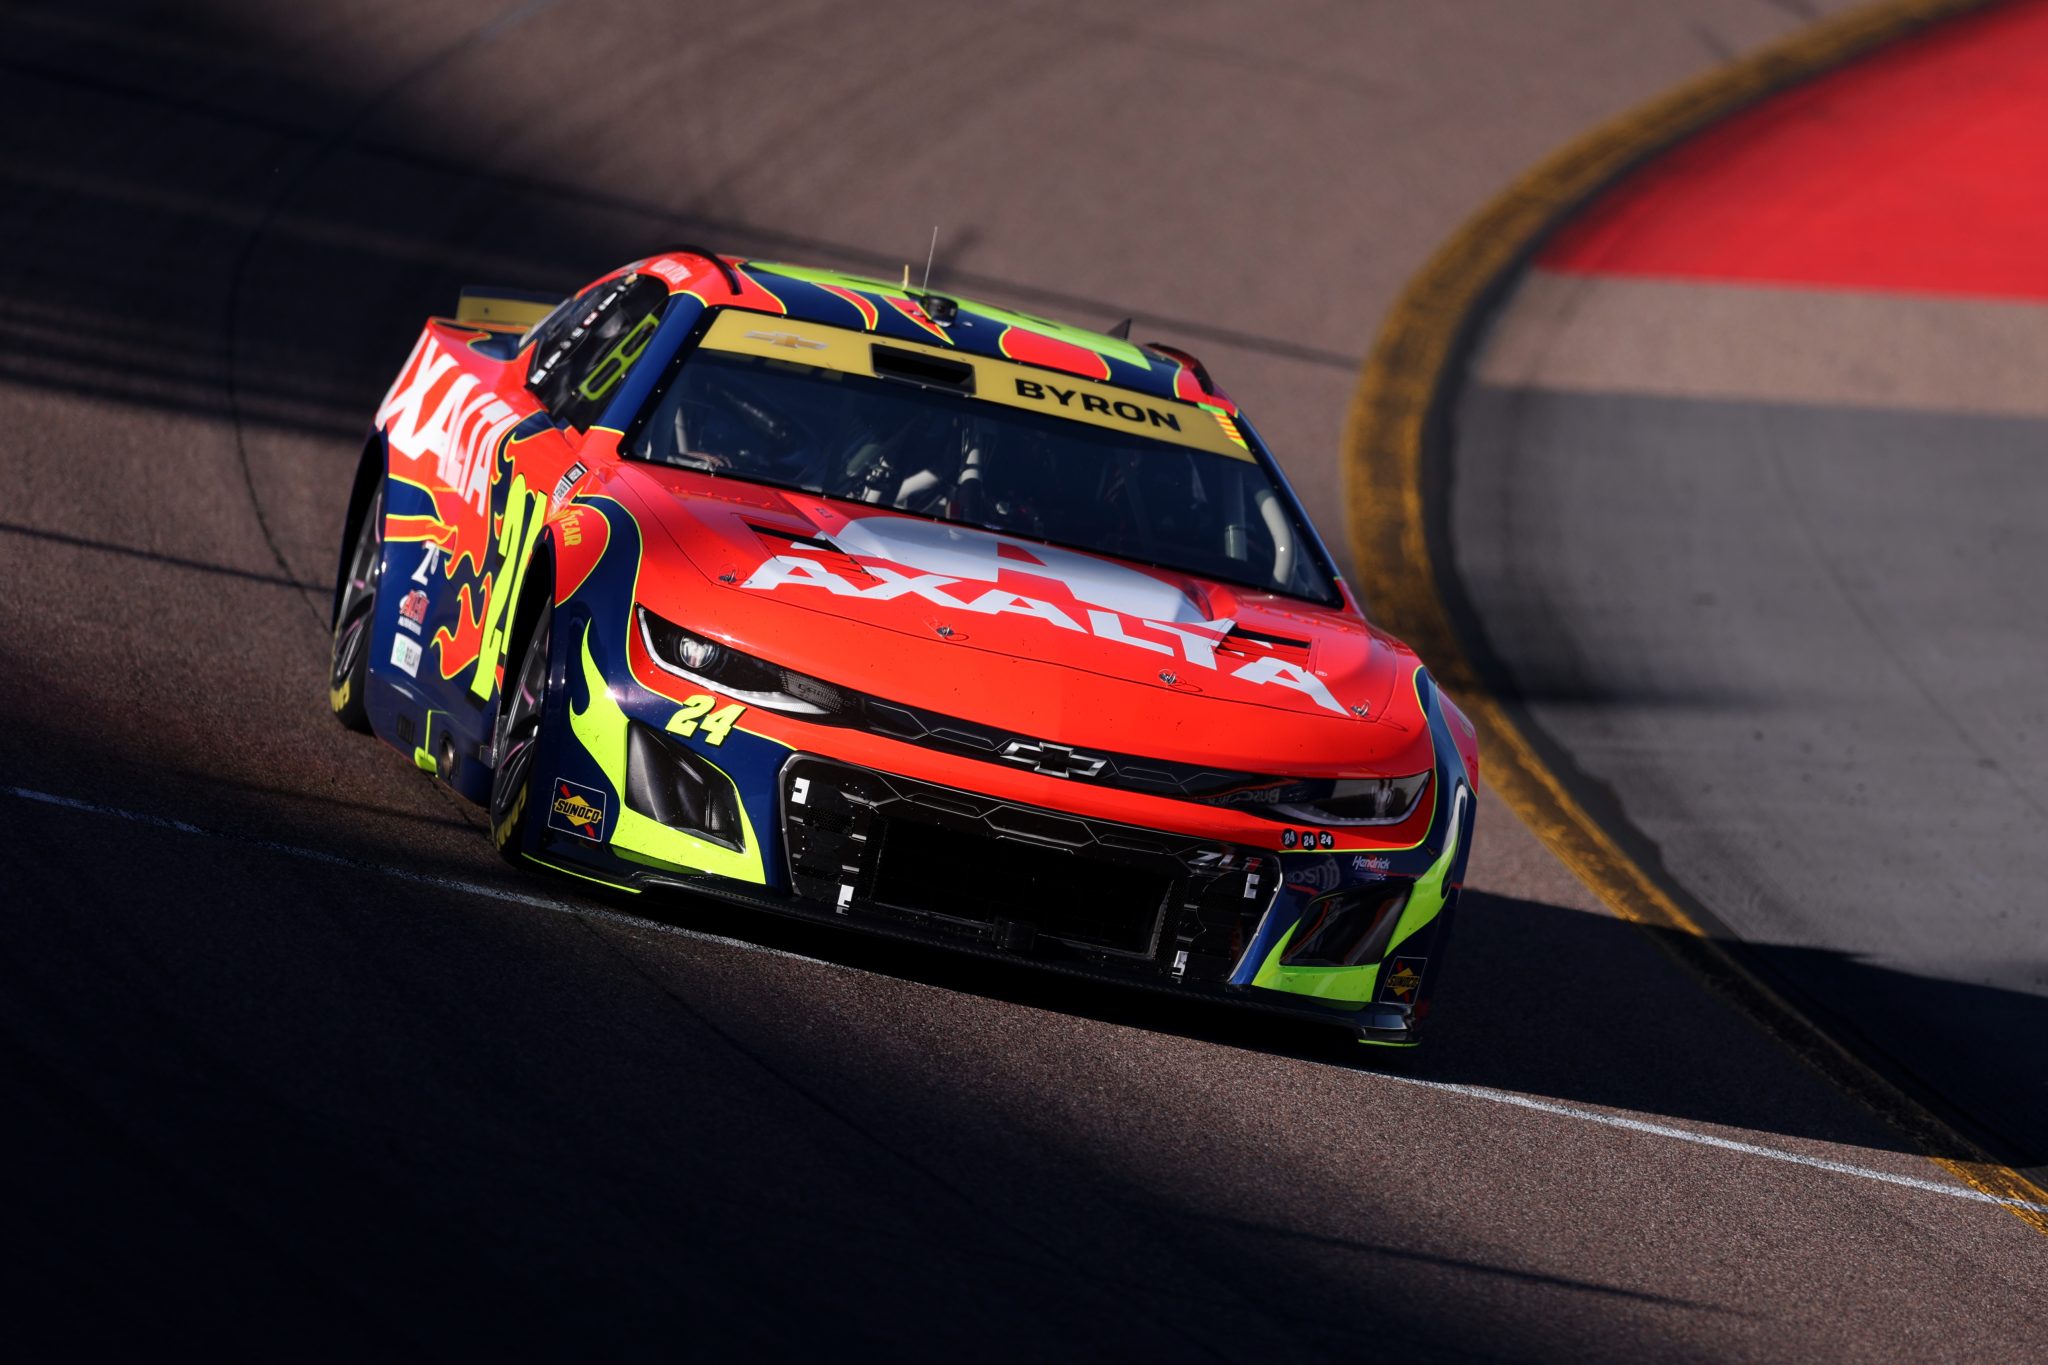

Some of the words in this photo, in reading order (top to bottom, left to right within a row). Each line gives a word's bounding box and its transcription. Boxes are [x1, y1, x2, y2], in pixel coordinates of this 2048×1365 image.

[1014, 379, 1182, 431] BYRON
[742, 555, 1351, 717] AXALTA
[665, 694, 747, 746] 24
[555, 800, 601, 822] SUNOCO
[1284, 831, 1295, 845] 24
[1303, 835, 1314, 847] 24
[1320, 833, 1332, 845] 24
[1352, 856, 1390, 870] Hendrick
